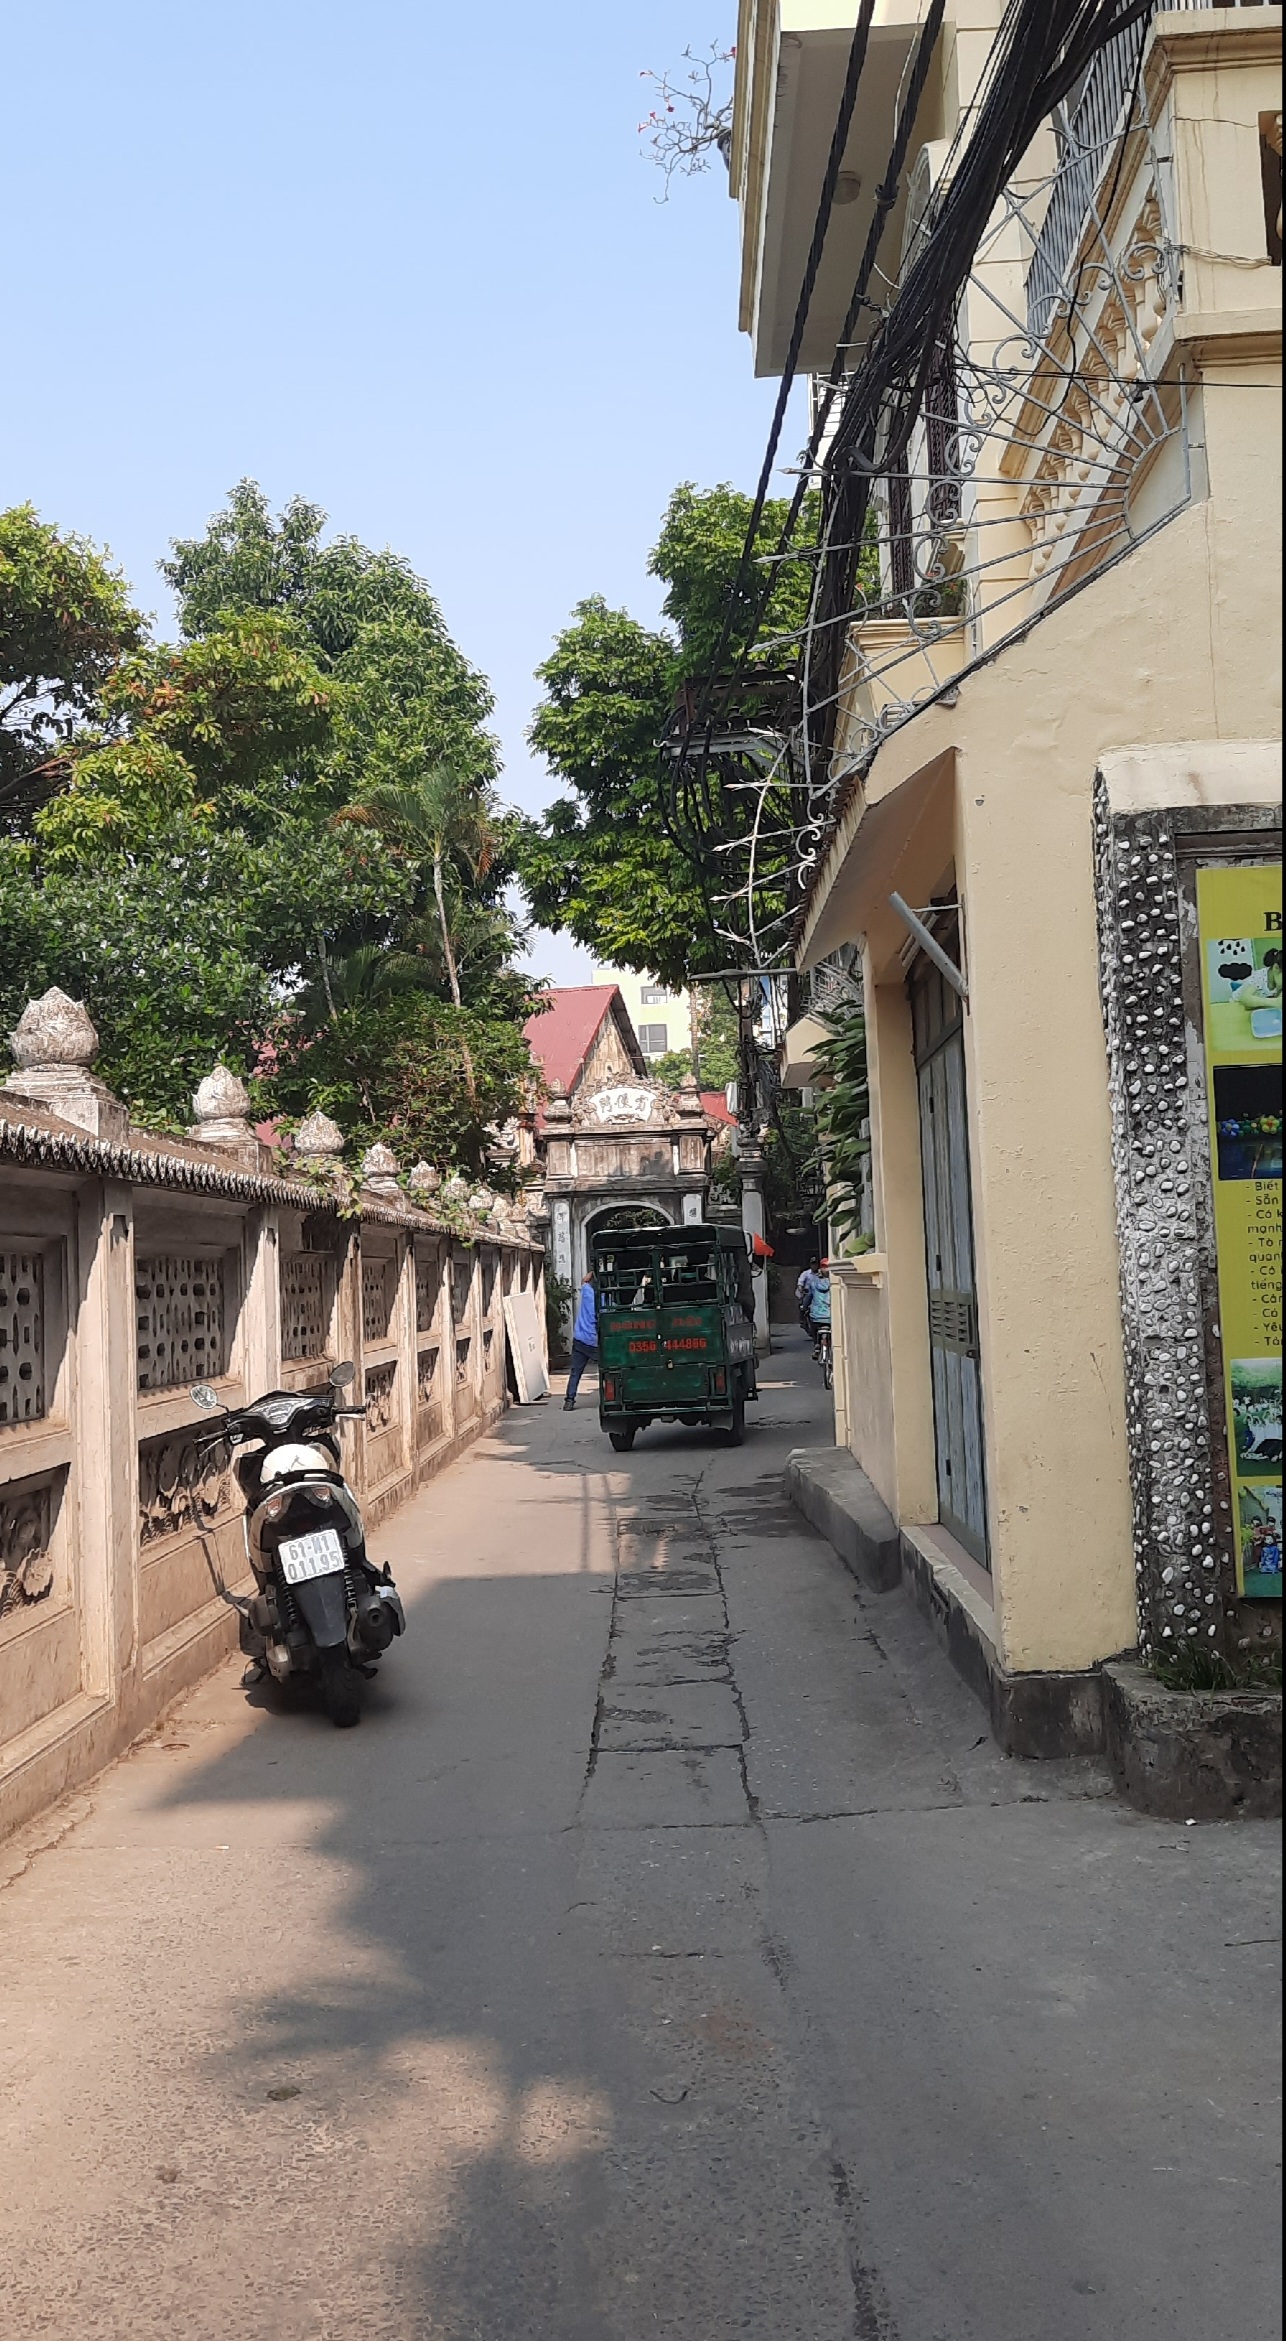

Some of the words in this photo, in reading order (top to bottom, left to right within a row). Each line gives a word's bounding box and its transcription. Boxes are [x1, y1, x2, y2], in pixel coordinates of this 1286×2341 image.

[1255, 1179, 1279, 1191] Biết
[1256, 1209, 1272, 1219] Có
[1247, 1222, 1283, 1235] mạnh
[1249, 1252, 1283, 1263] quan
[1251, 1277, 1283, 1291] tiếng
